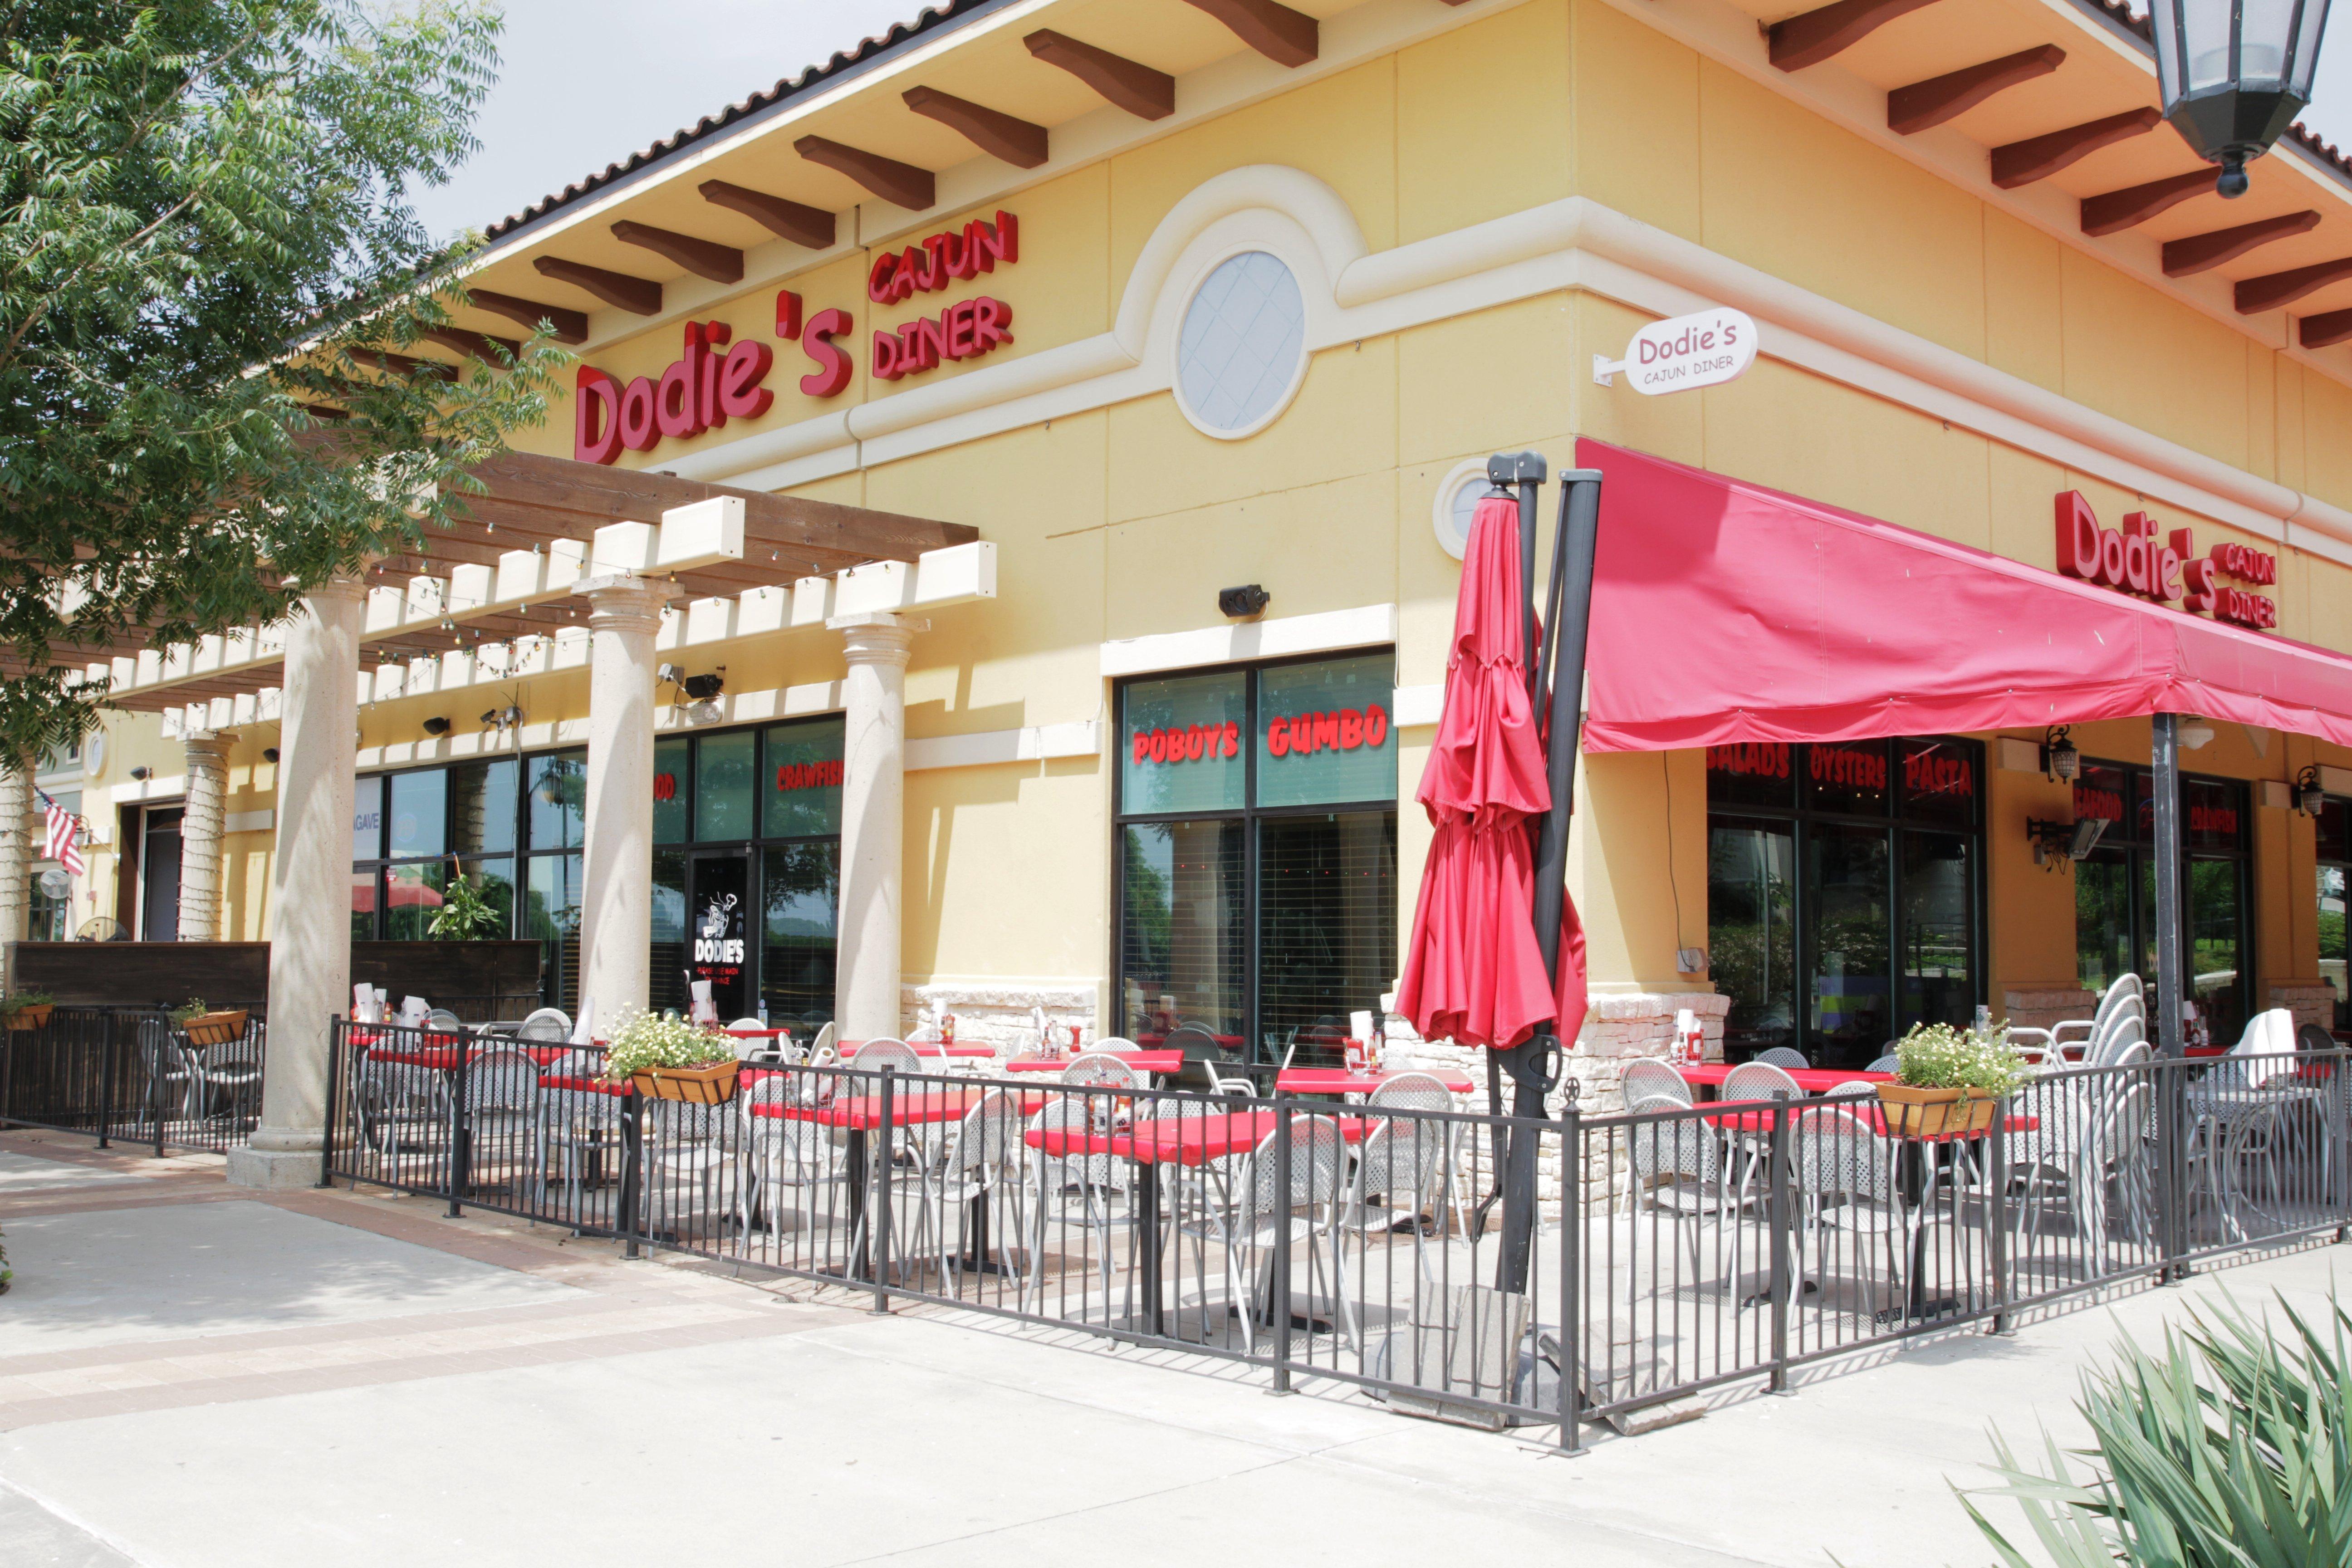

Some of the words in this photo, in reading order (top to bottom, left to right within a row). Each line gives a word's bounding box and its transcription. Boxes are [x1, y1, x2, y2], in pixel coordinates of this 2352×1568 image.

[869, 210, 1018, 305] CAJUN
[872, 296, 1014, 381] DINER
[1639, 320, 1737, 364] Dodie's
[575, 289, 853, 466] Dodie's
[1644, 365, 1686, 384] CAJUN
[1694, 356, 1734, 374] DINER
[2054, 490, 2218, 612] Dodie's
[2210, 543, 2276, 586] CAJUN
[2214, 587, 2277, 628] DINER
[1134, 720, 1239, 765] POBOYS
[1268, 703, 1387, 756] GUMBO
[1811, 743, 1886, 789] OYSTERS
[1906, 753, 1972, 797] PASTA
[695, 939, 744, 964] DODIE'S
